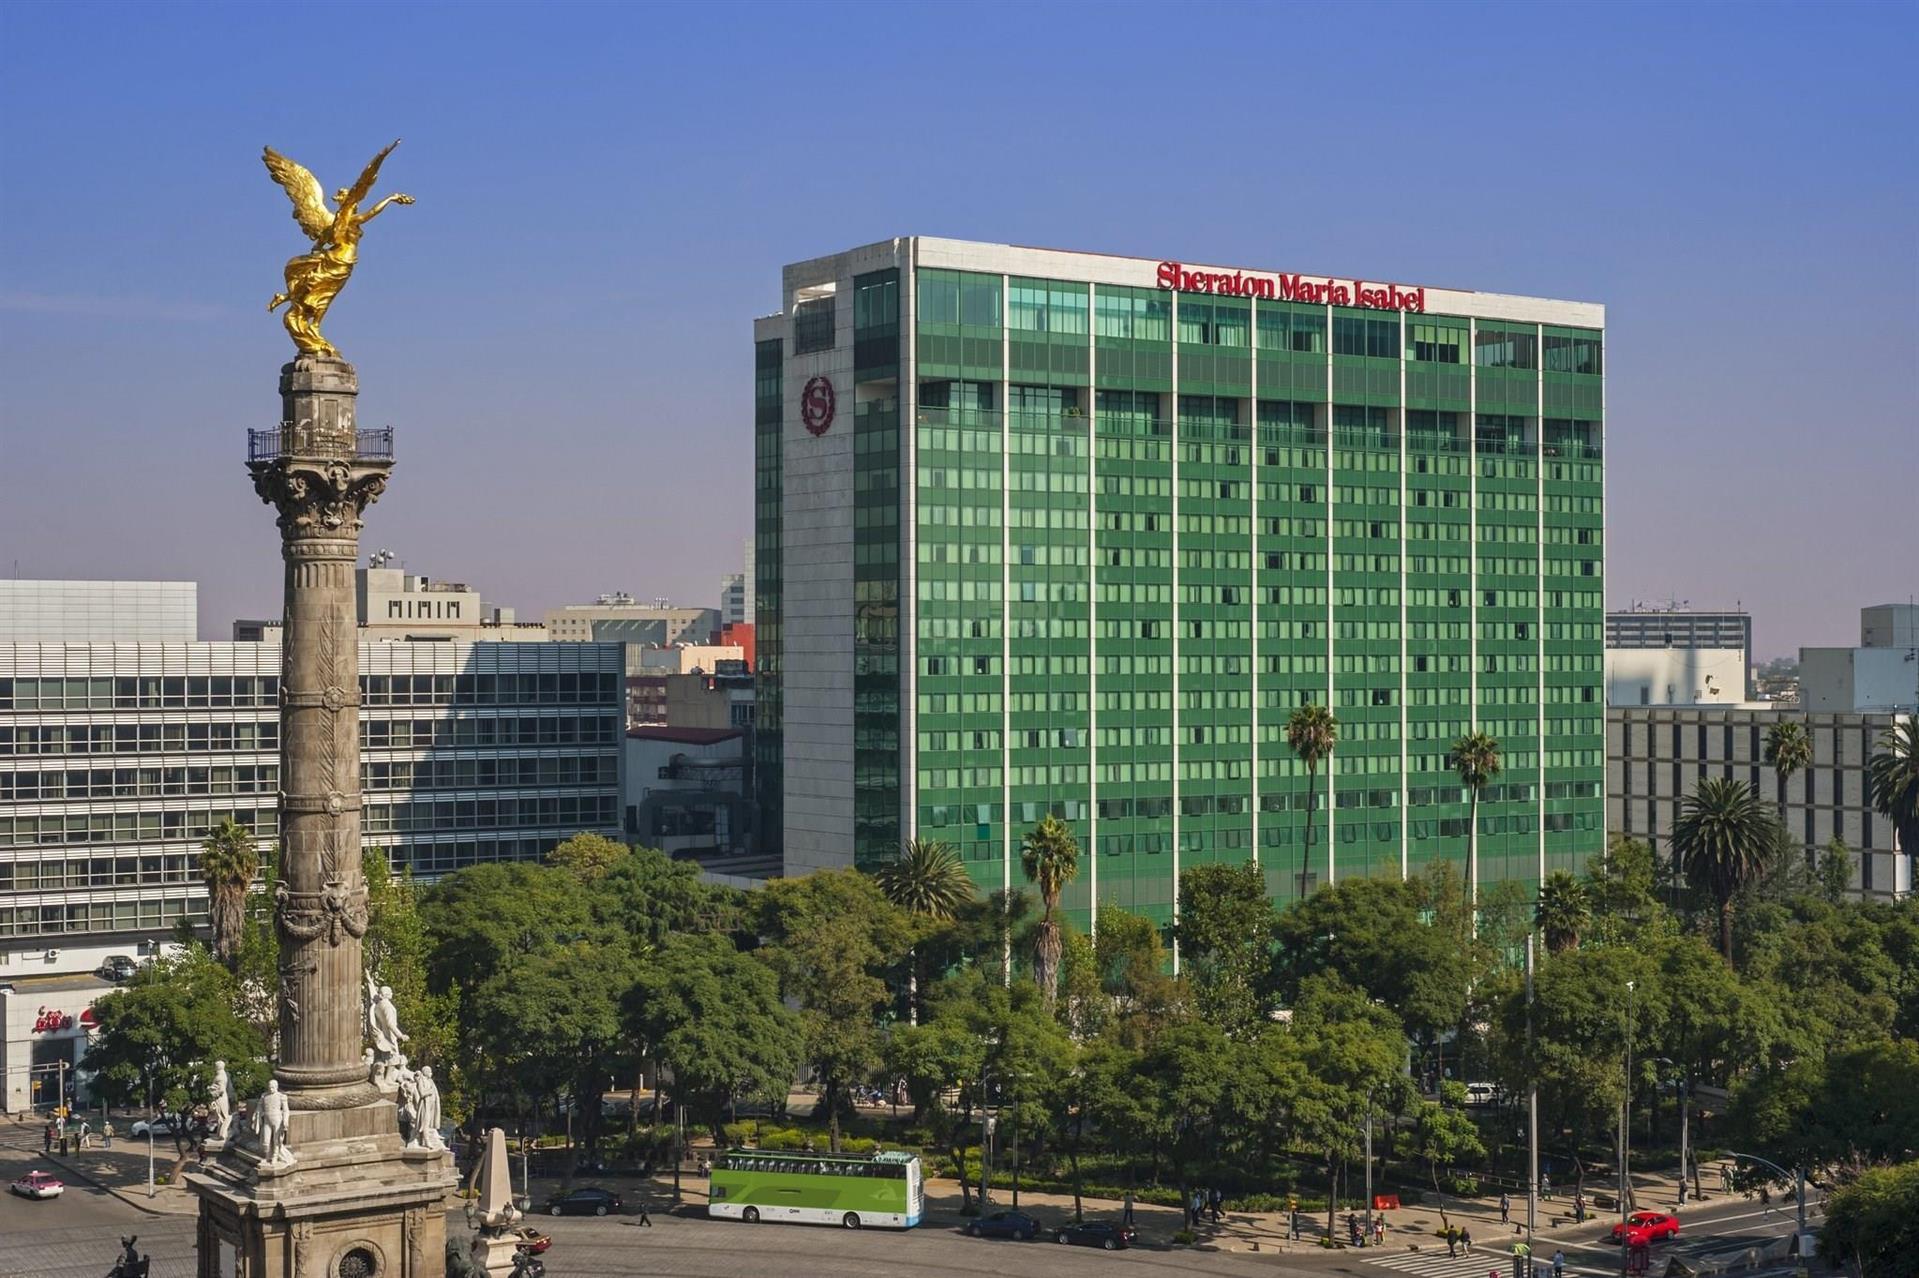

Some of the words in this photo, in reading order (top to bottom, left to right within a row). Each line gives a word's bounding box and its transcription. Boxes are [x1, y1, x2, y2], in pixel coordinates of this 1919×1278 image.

[1157, 261, 1275, 298] Sheraton
[1279, 273, 1350, 305] Maria
[1354, 281, 1425, 312] Isabel
[808, 385, 828, 420] S
